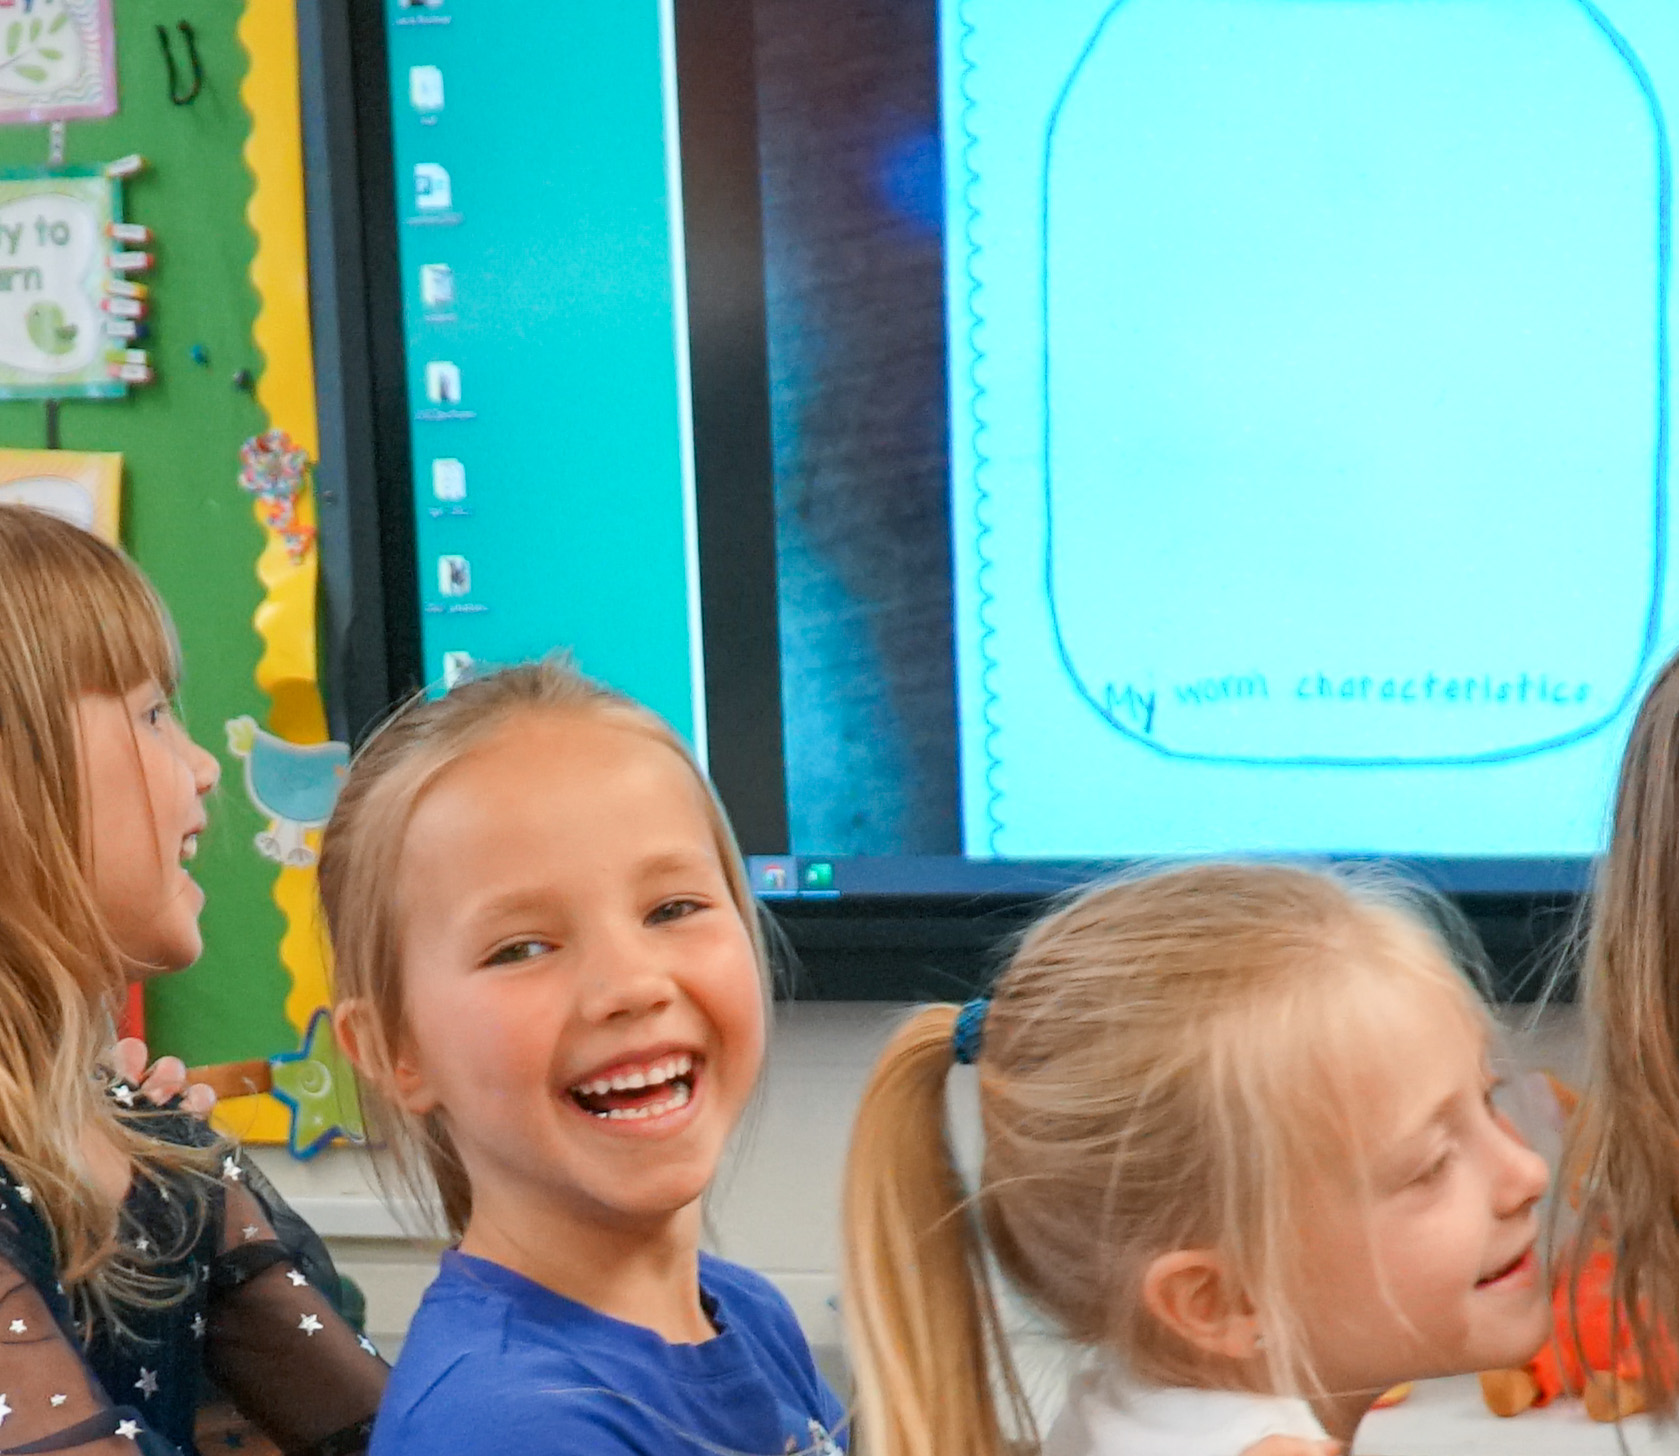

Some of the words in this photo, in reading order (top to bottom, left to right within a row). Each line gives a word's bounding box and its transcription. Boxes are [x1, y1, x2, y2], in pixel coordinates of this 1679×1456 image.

[34, 213, 71, 246] to
[1106, 681, 1156, 734] My
[1175, 671, 1269, 704] worm
